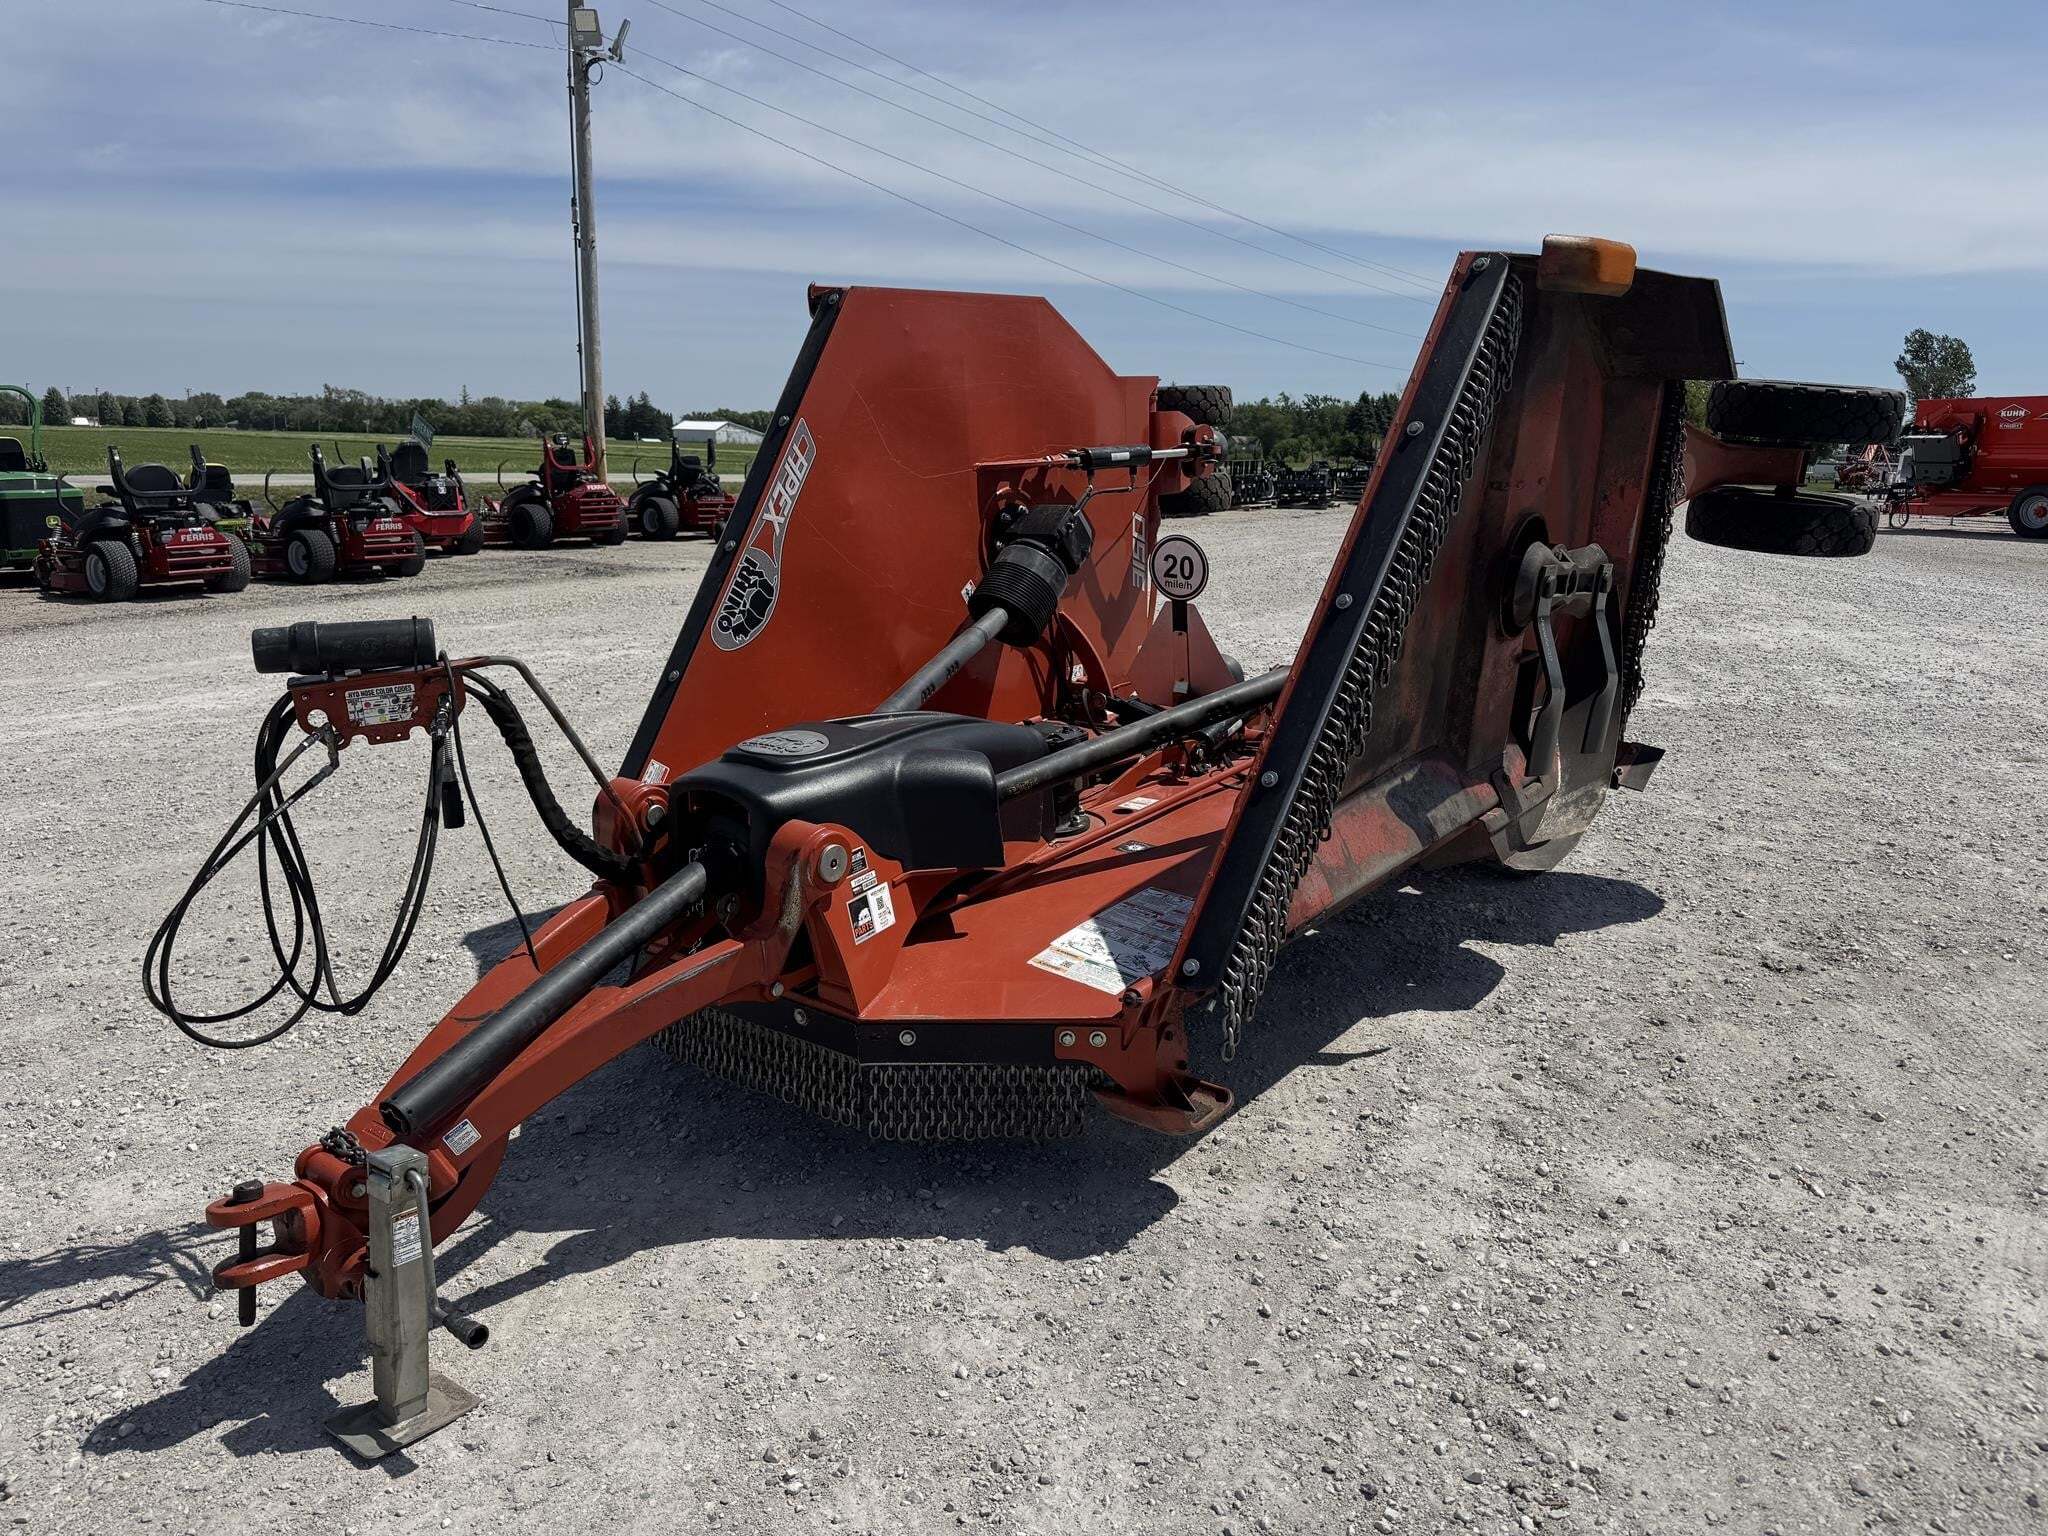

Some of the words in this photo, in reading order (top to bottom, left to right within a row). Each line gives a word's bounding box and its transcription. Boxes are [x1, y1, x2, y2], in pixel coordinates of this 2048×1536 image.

[2000, 409, 2025, 417] KUHN
[762, 440, 809, 537] APEX
[375, 522, 403, 531] FERRIS
[180, 532, 215, 542] FERRIS
[1132, 512, 1146, 592] 3150
[1163, 553, 1195, 581] 20
[1164, 580, 1193, 591] mile/h
[717, 554, 764, 634] RHINO
[360, 689, 376, 697] HOSE
[375, 686, 394, 695] COLOR
[854, 921, 874, 938] PARTS
